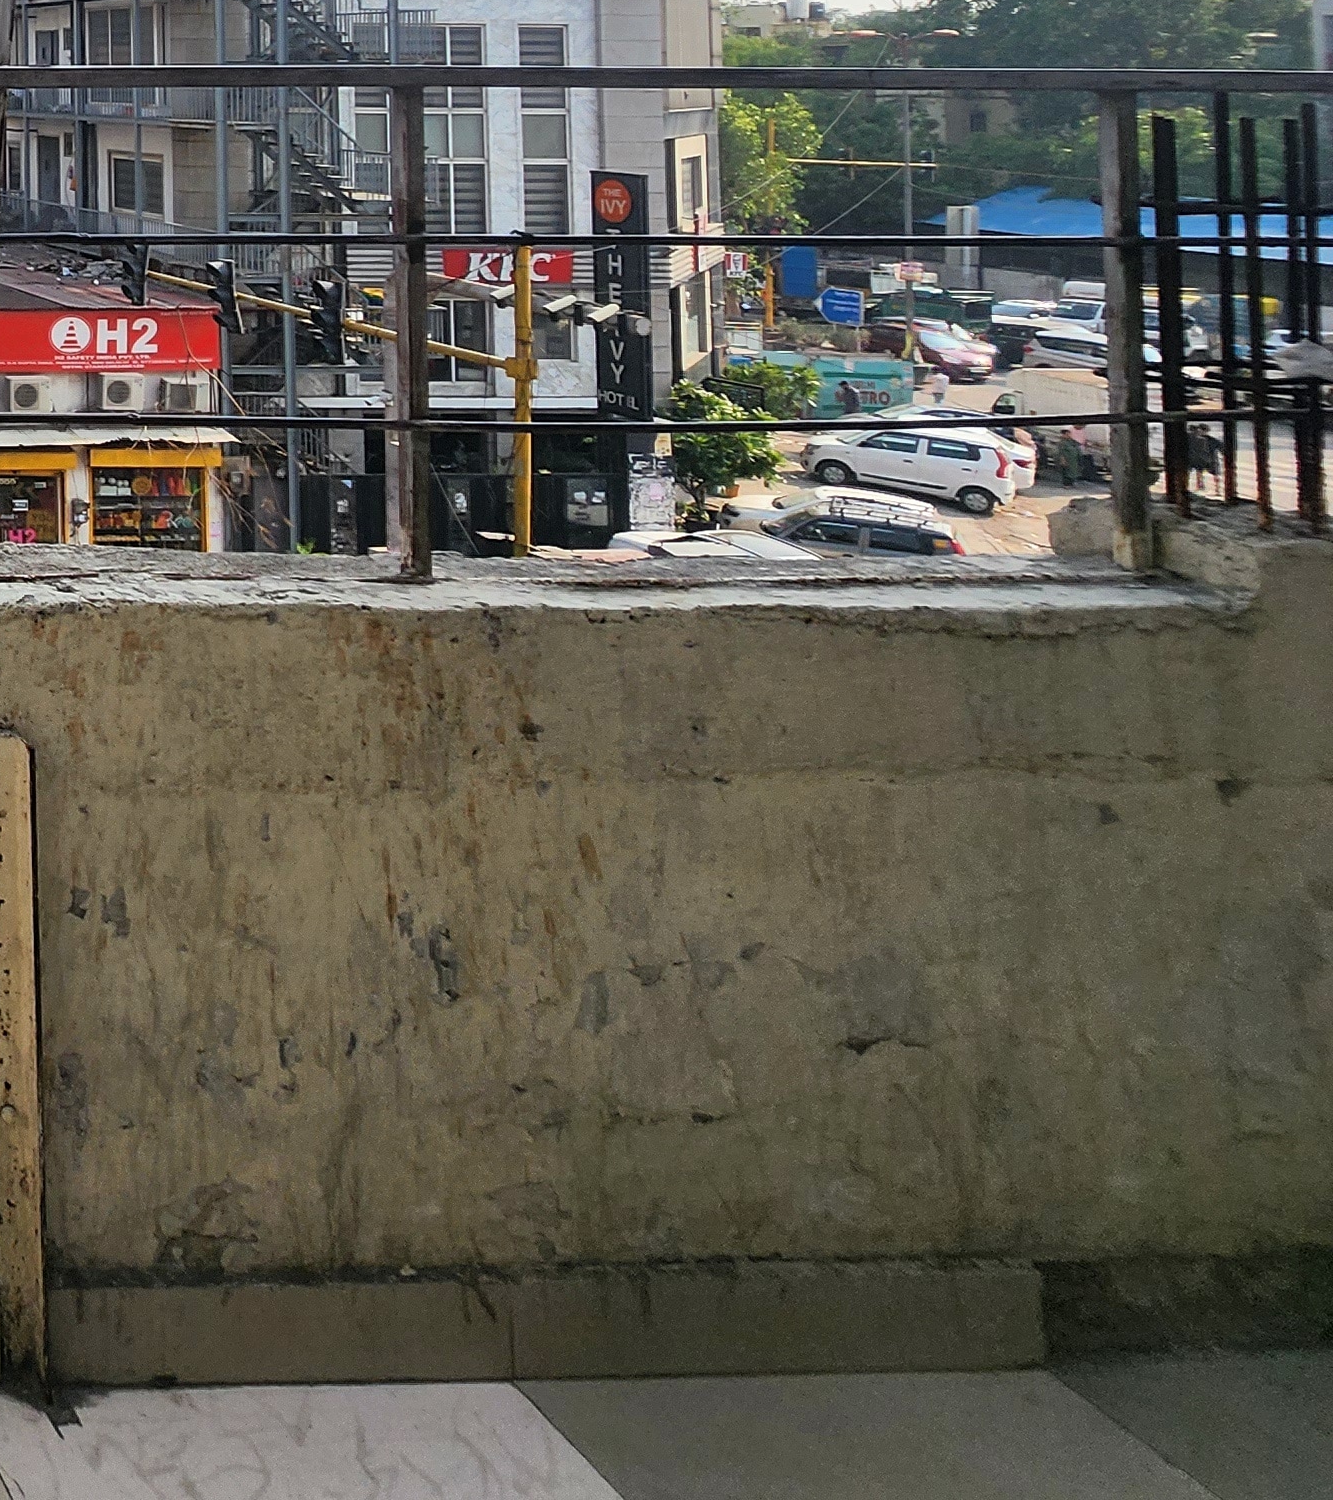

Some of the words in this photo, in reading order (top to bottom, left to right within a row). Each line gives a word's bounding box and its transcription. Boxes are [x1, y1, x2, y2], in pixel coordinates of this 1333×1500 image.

[603, 189, 621, 197] THE
[600, 200, 627, 215] IVY
[96, 317, 158, 354] H2
